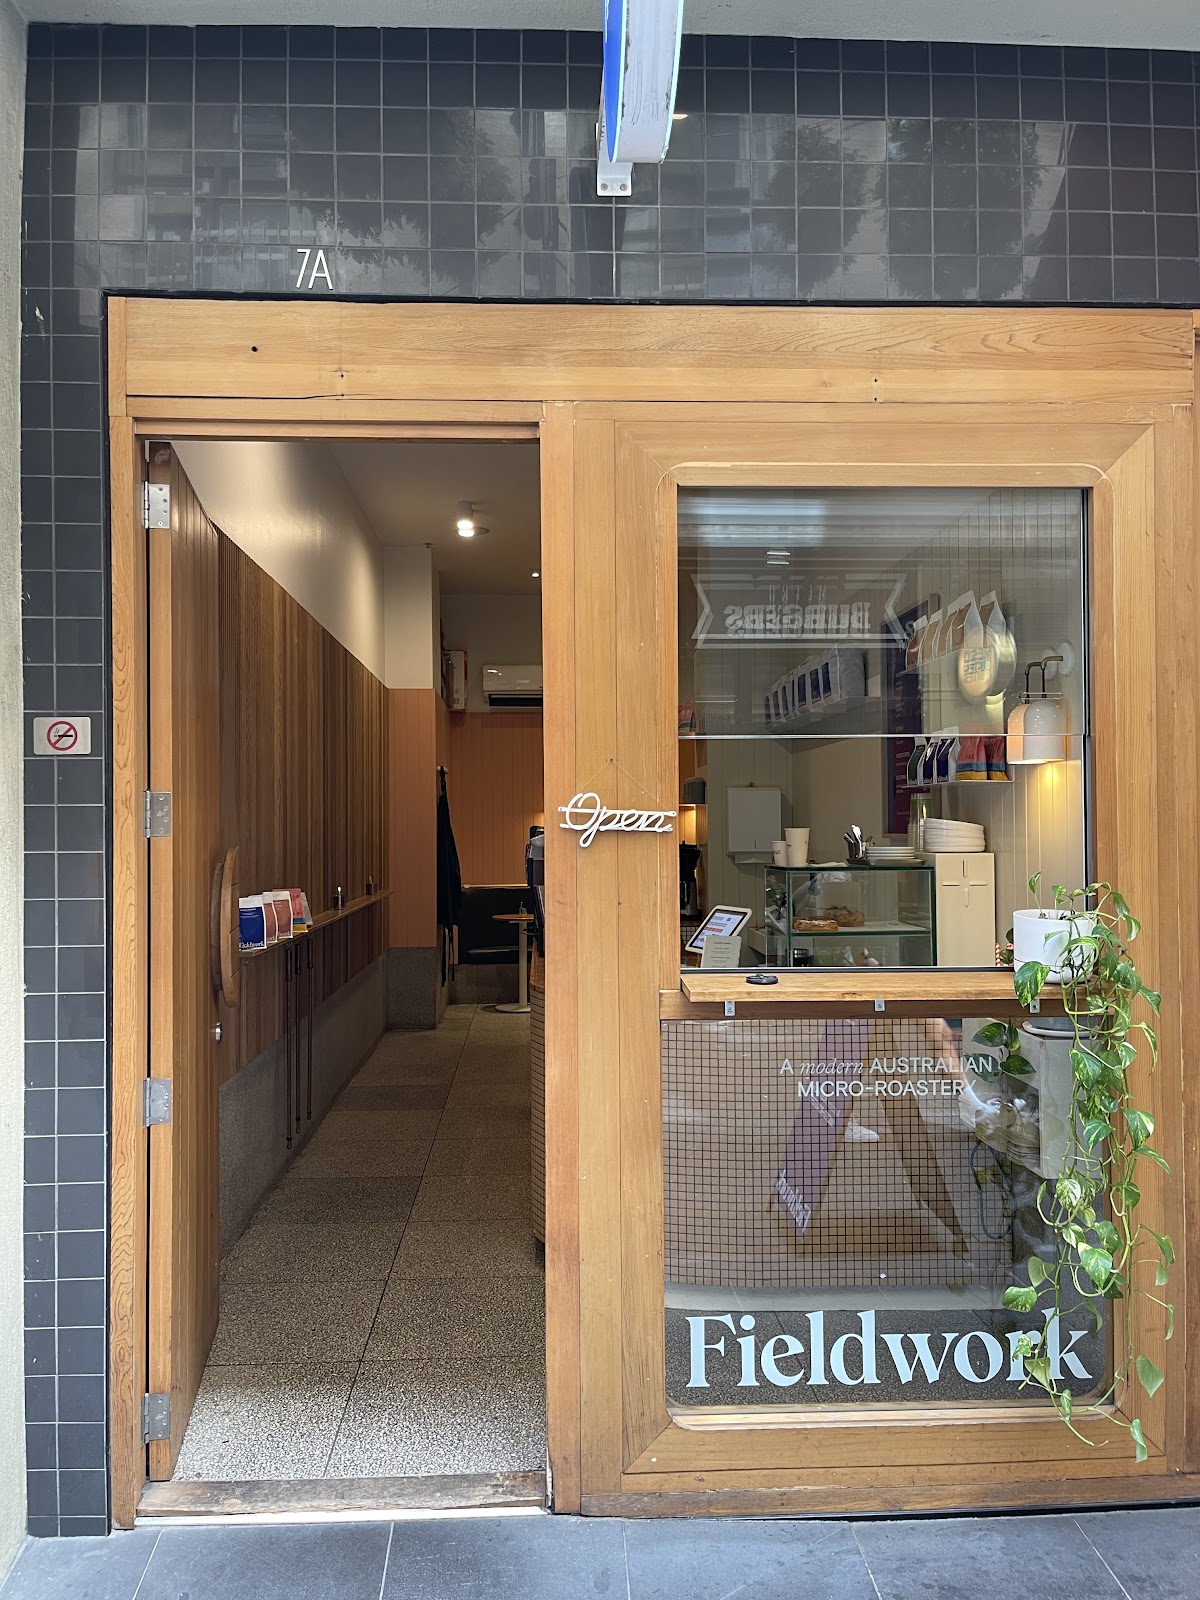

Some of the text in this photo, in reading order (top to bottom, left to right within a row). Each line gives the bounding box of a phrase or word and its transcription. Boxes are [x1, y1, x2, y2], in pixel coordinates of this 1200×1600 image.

[296, 248, 334, 290] 7A
[564, 792, 674, 848] Open
[779, 1056, 993, 1075] A modern AUSTRALIAN
[686, 1308, 1093, 1388] Fieldwork
